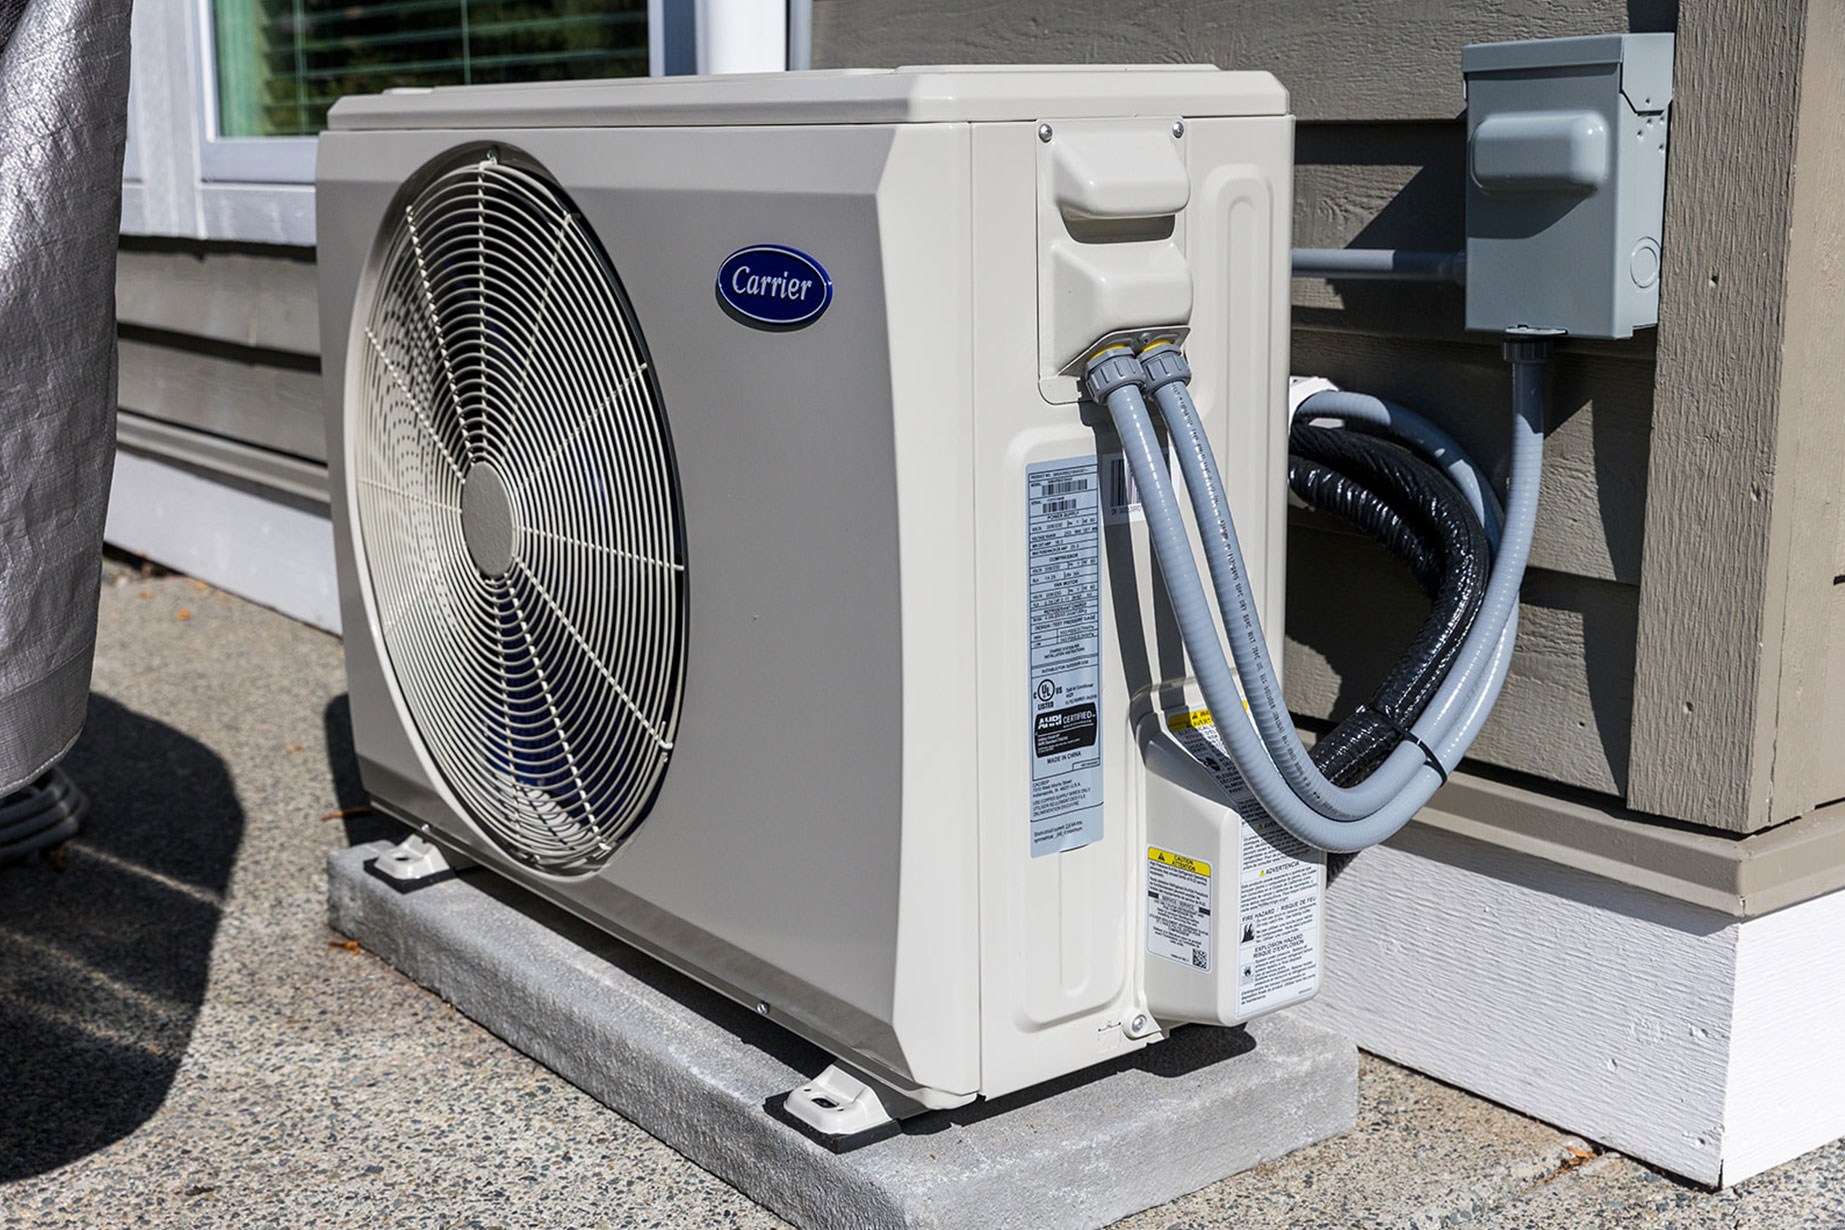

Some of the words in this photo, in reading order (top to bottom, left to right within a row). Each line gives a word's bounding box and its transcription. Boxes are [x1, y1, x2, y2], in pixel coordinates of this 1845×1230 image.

[732, 265, 812, 300] Carrier
[1042, 684, 1050, 696] UL
[1038, 701, 1054, 710] LISTED
[1038, 714, 1062, 730] AHRI
[1063, 710, 1092, 724] CERTIFIED
[1047, 756, 1061, 764] MADE
[1068, 750, 1082, 759] CHINA
[1174, 854, 1194, 865] CAUTION
[1266, 861, 1300, 875] ADVERTENCIA
[1255, 908, 1276, 918] HAZARD
[1281, 902, 1298, 910] RISQUE
[1255, 940, 1283, 952] EXPLOSION
[1284, 934, 1304, 942] HAZARD
[1254, 950, 1271, 958] RISQUE
